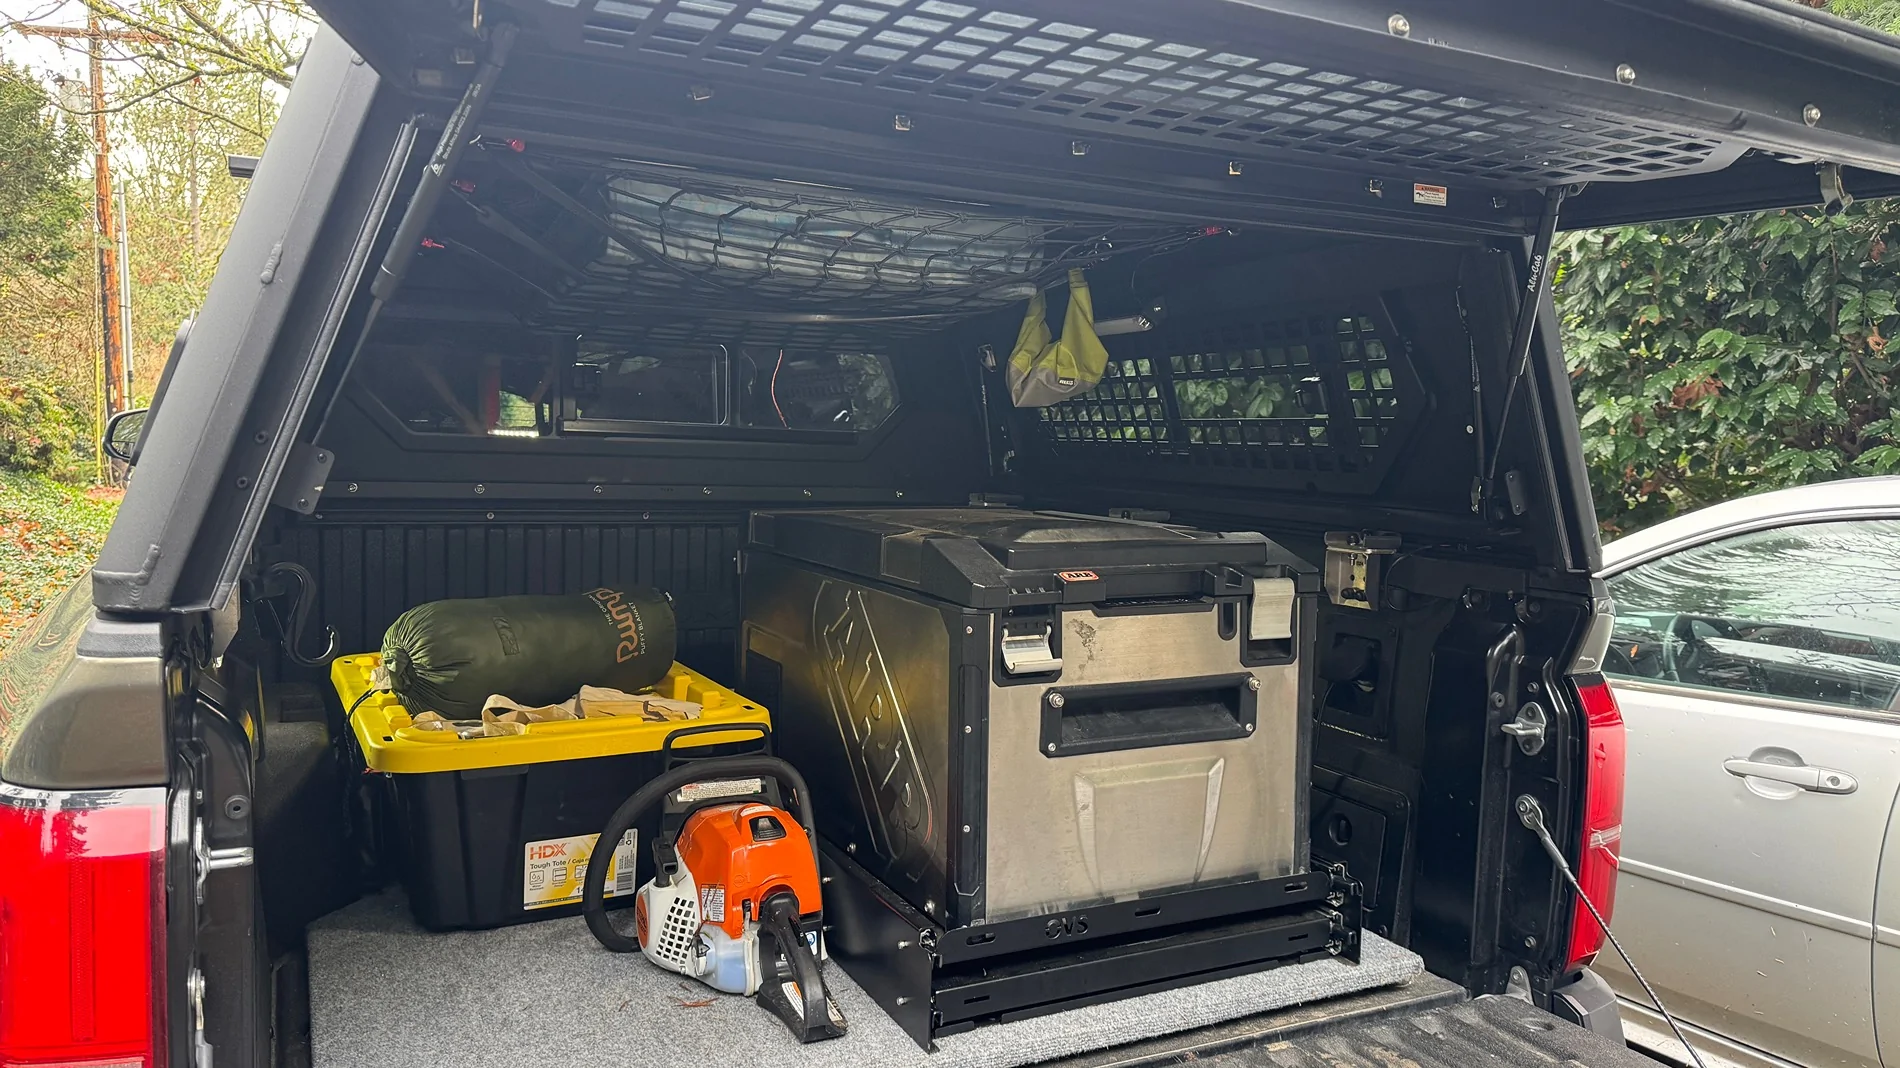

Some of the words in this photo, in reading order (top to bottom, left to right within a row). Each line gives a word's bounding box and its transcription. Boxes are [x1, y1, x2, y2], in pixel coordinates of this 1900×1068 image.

[627, 601, 644, 631] BLANKET
[530, 842, 567, 861] HDX
[530, 861, 551, 870] Tough
[552, 859, 567, 868] Tote
[1045, 914, 1089, 940] OVS
